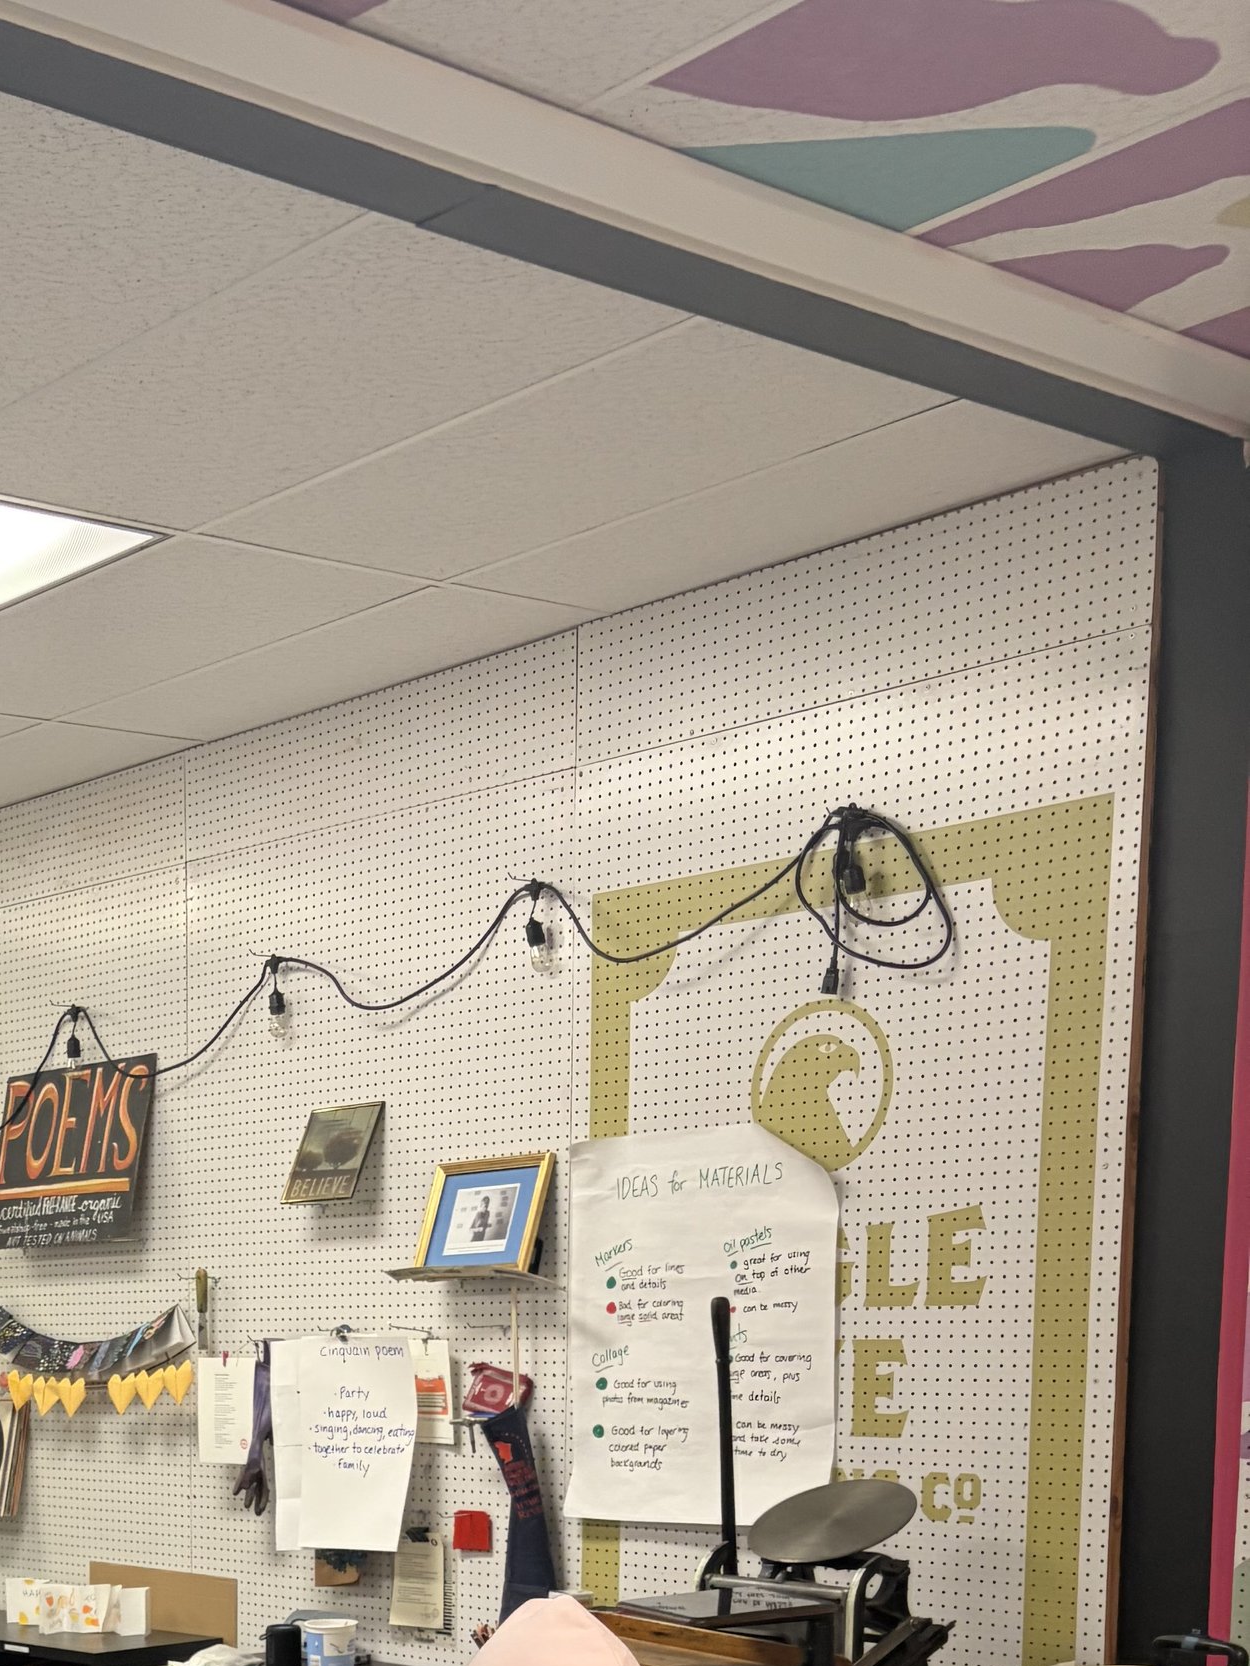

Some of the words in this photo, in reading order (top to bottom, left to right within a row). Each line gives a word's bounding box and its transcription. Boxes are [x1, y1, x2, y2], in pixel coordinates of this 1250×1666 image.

[290, 1174, 351, 1197] BELIEVE
[617, 1174, 658, 1200] IDEAS
[668, 1170, 687, 1195] for
[699, 1162, 783, 1189] MATERIALS
[24, 1233, 53, 1247] TESTED
[723, 1238, 736, 1253] Oil
[739, 1226, 772, 1250] pastels
[595, 1239, 633, 1266] Markers
[743, 1255, 766, 1270] great
[770, 1252, 782, 1264] for
[788, 1250, 810, 1265] using
[837, 1204, 988, 1307] LE
[619, 1265, 643, 1279] Good
[647, 1263, 661, 1275] for
[665, 1262, 685, 1275] lines
[752, 1269, 766, 1281] top
[770, 1267, 779, 1278] of
[784, 1265, 812, 1276] other
[621, 1279, 635, 1291] and
[639, 1278, 667, 1290] details
[618, 1301, 632, 1311] Bad
[637, 1299, 649, 1310] for
[652, 1299, 684, 1313] coloring
[743, 1304, 757, 1313] can
[759, 1302, 768, 1312] be
[773, 1301, 799, 1313] messy
[320, 1346, 370, 1363] Cinquain
[375, 1345, 404, 1360] poem
[592, 1345, 629, 1366] Collage
[735, 1353, 754, 1363] Good
[759, 1351, 770, 1363] for
[775, 1352, 812, 1369] covering
[782, 1371, 801, 1382] plus
[340, 1386, 369, 1401] Party
[613, 1379, 634, 1389] Good
[637, 1378, 650, 1389] for
[654, 1380, 677, 1395] using
[836, 1339, 909, 1438] E
[627, 1392, 644, 1404] from
[748, 1389, 781, 1404] details
[363, 1407, 388, 1419] loud
[388, 1424, 414, 1446] eating
[611, 1426, 635, 1436] Good
[639, 1425, 654, 1436] for
[657, 1426, 689, 1443] layering
[735, 1420, 752, 1430] can
[757, 1420, 767, 1430] be
[770, 1421, 800, 1435] messy
[313, 1442, 349, 1457] together
[352, 1442, 362, 1454] to
[364, 1444, 405, 1454] celebrate
[608, 1442, 639, 1452] colored
[644, 1443, 667, 1457] paper
[758, 1447, 767, 1457] to
[770, 1446, 787, 1461] dry
